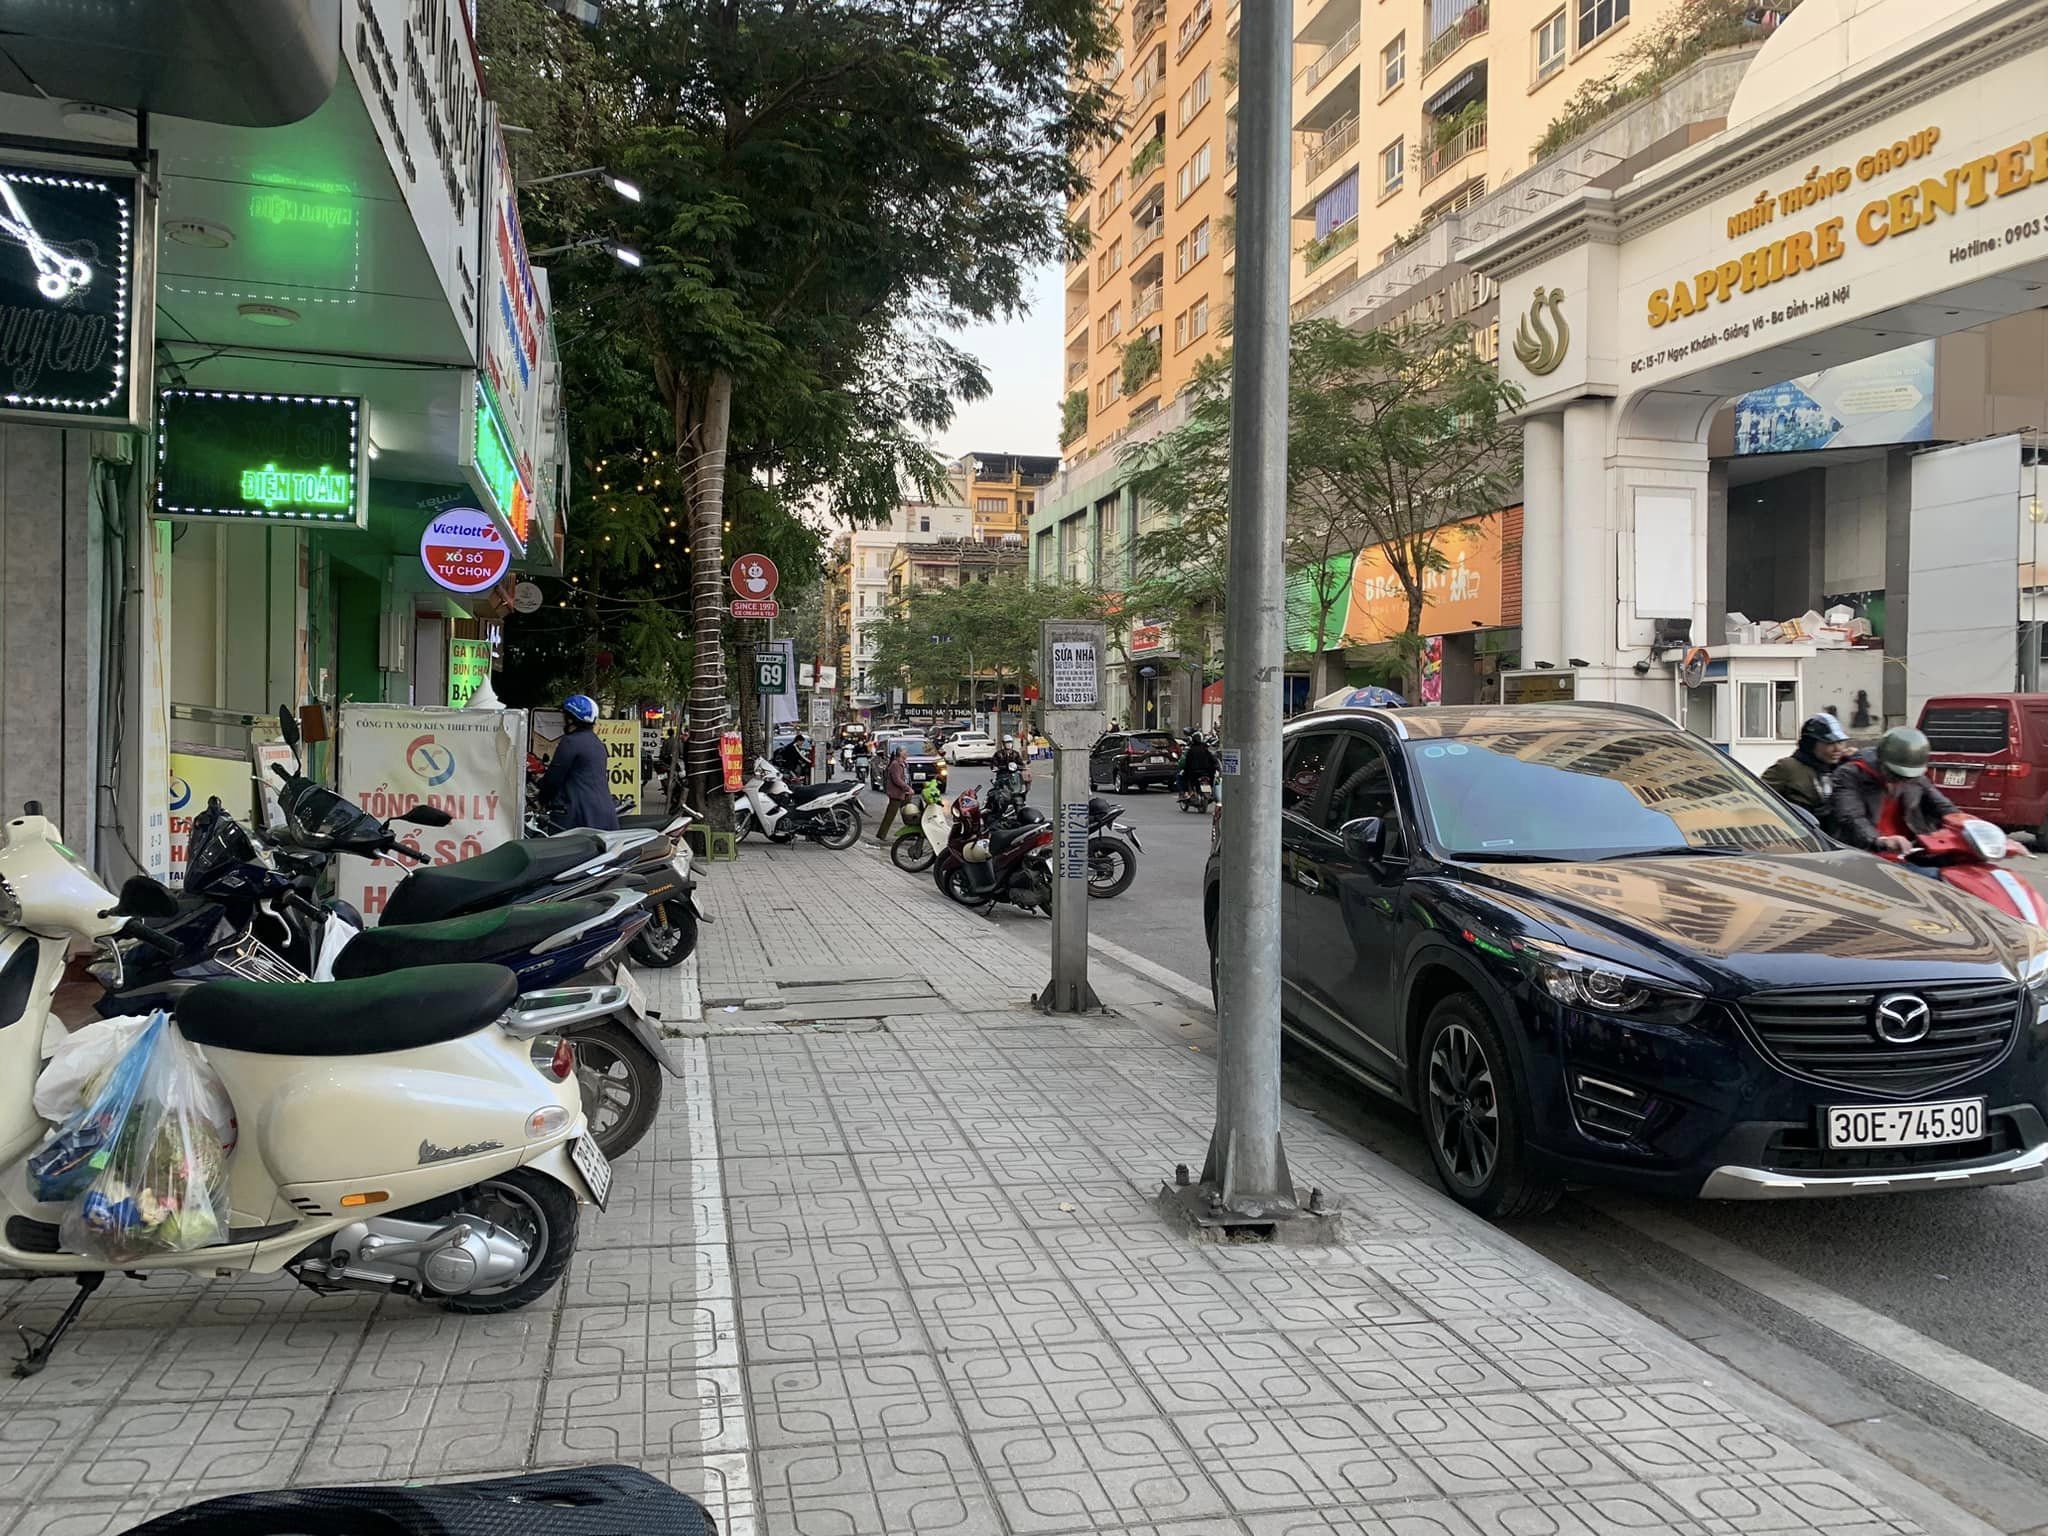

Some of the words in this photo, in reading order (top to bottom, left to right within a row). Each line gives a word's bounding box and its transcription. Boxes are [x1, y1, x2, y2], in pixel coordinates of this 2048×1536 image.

[1727, 190, 1776, 239] NHẤT
[1779, 165, 1850, 216] THỐNG
[1856, 126, 1941, 182] GROUP
[2005, 219, 2041, 245] 0903
[1647, 216, 1845, 328] SAPPHIRE
[1667, 346, 1689, 363] Ngọc
[1690, 335, 1717, 354] Khánh
[1723, 324, 1750, 342] Giảng
[1771, 310, 1785, 325] Ba
[1786, 299, 1808, 318] Đình
[1815, 292, 1830, 310] Hà
[1832, 285, 1850, 305] Nội
[241, 462, 290, 508] ĐIỆN
[293, 465, 347, 504] TOÁN
[433, 523, 482, 538] Vietlott
[446, 550, 463, 562] XỔ
[466, 552, 484, 563] SỐ
[438, 564, 454, 576] TỰ
[456, 567, 492, 578] CHỌN
[734, 602, 758, 610] SINCE
[759, 602, 775, 611] 1997
[1054, 643, 1073, 662] SỬA
[1075, 646, 1095, 662] NHÀ
[760, 664, 782, 686] 69
[1071, 693, 1082, 703] 123
[904, 707, 921, 716] SIÊU
[356, 718, 382, 728] CÔNG
[384, 720, 394, 729] TY
[359, 783, 419, 819] TỔNG
[473, 790, 499, 821] LÝ
[434, 830, 482, 868] SỐ
[1835, 1105, 1978, 1144] 30E-745.90
